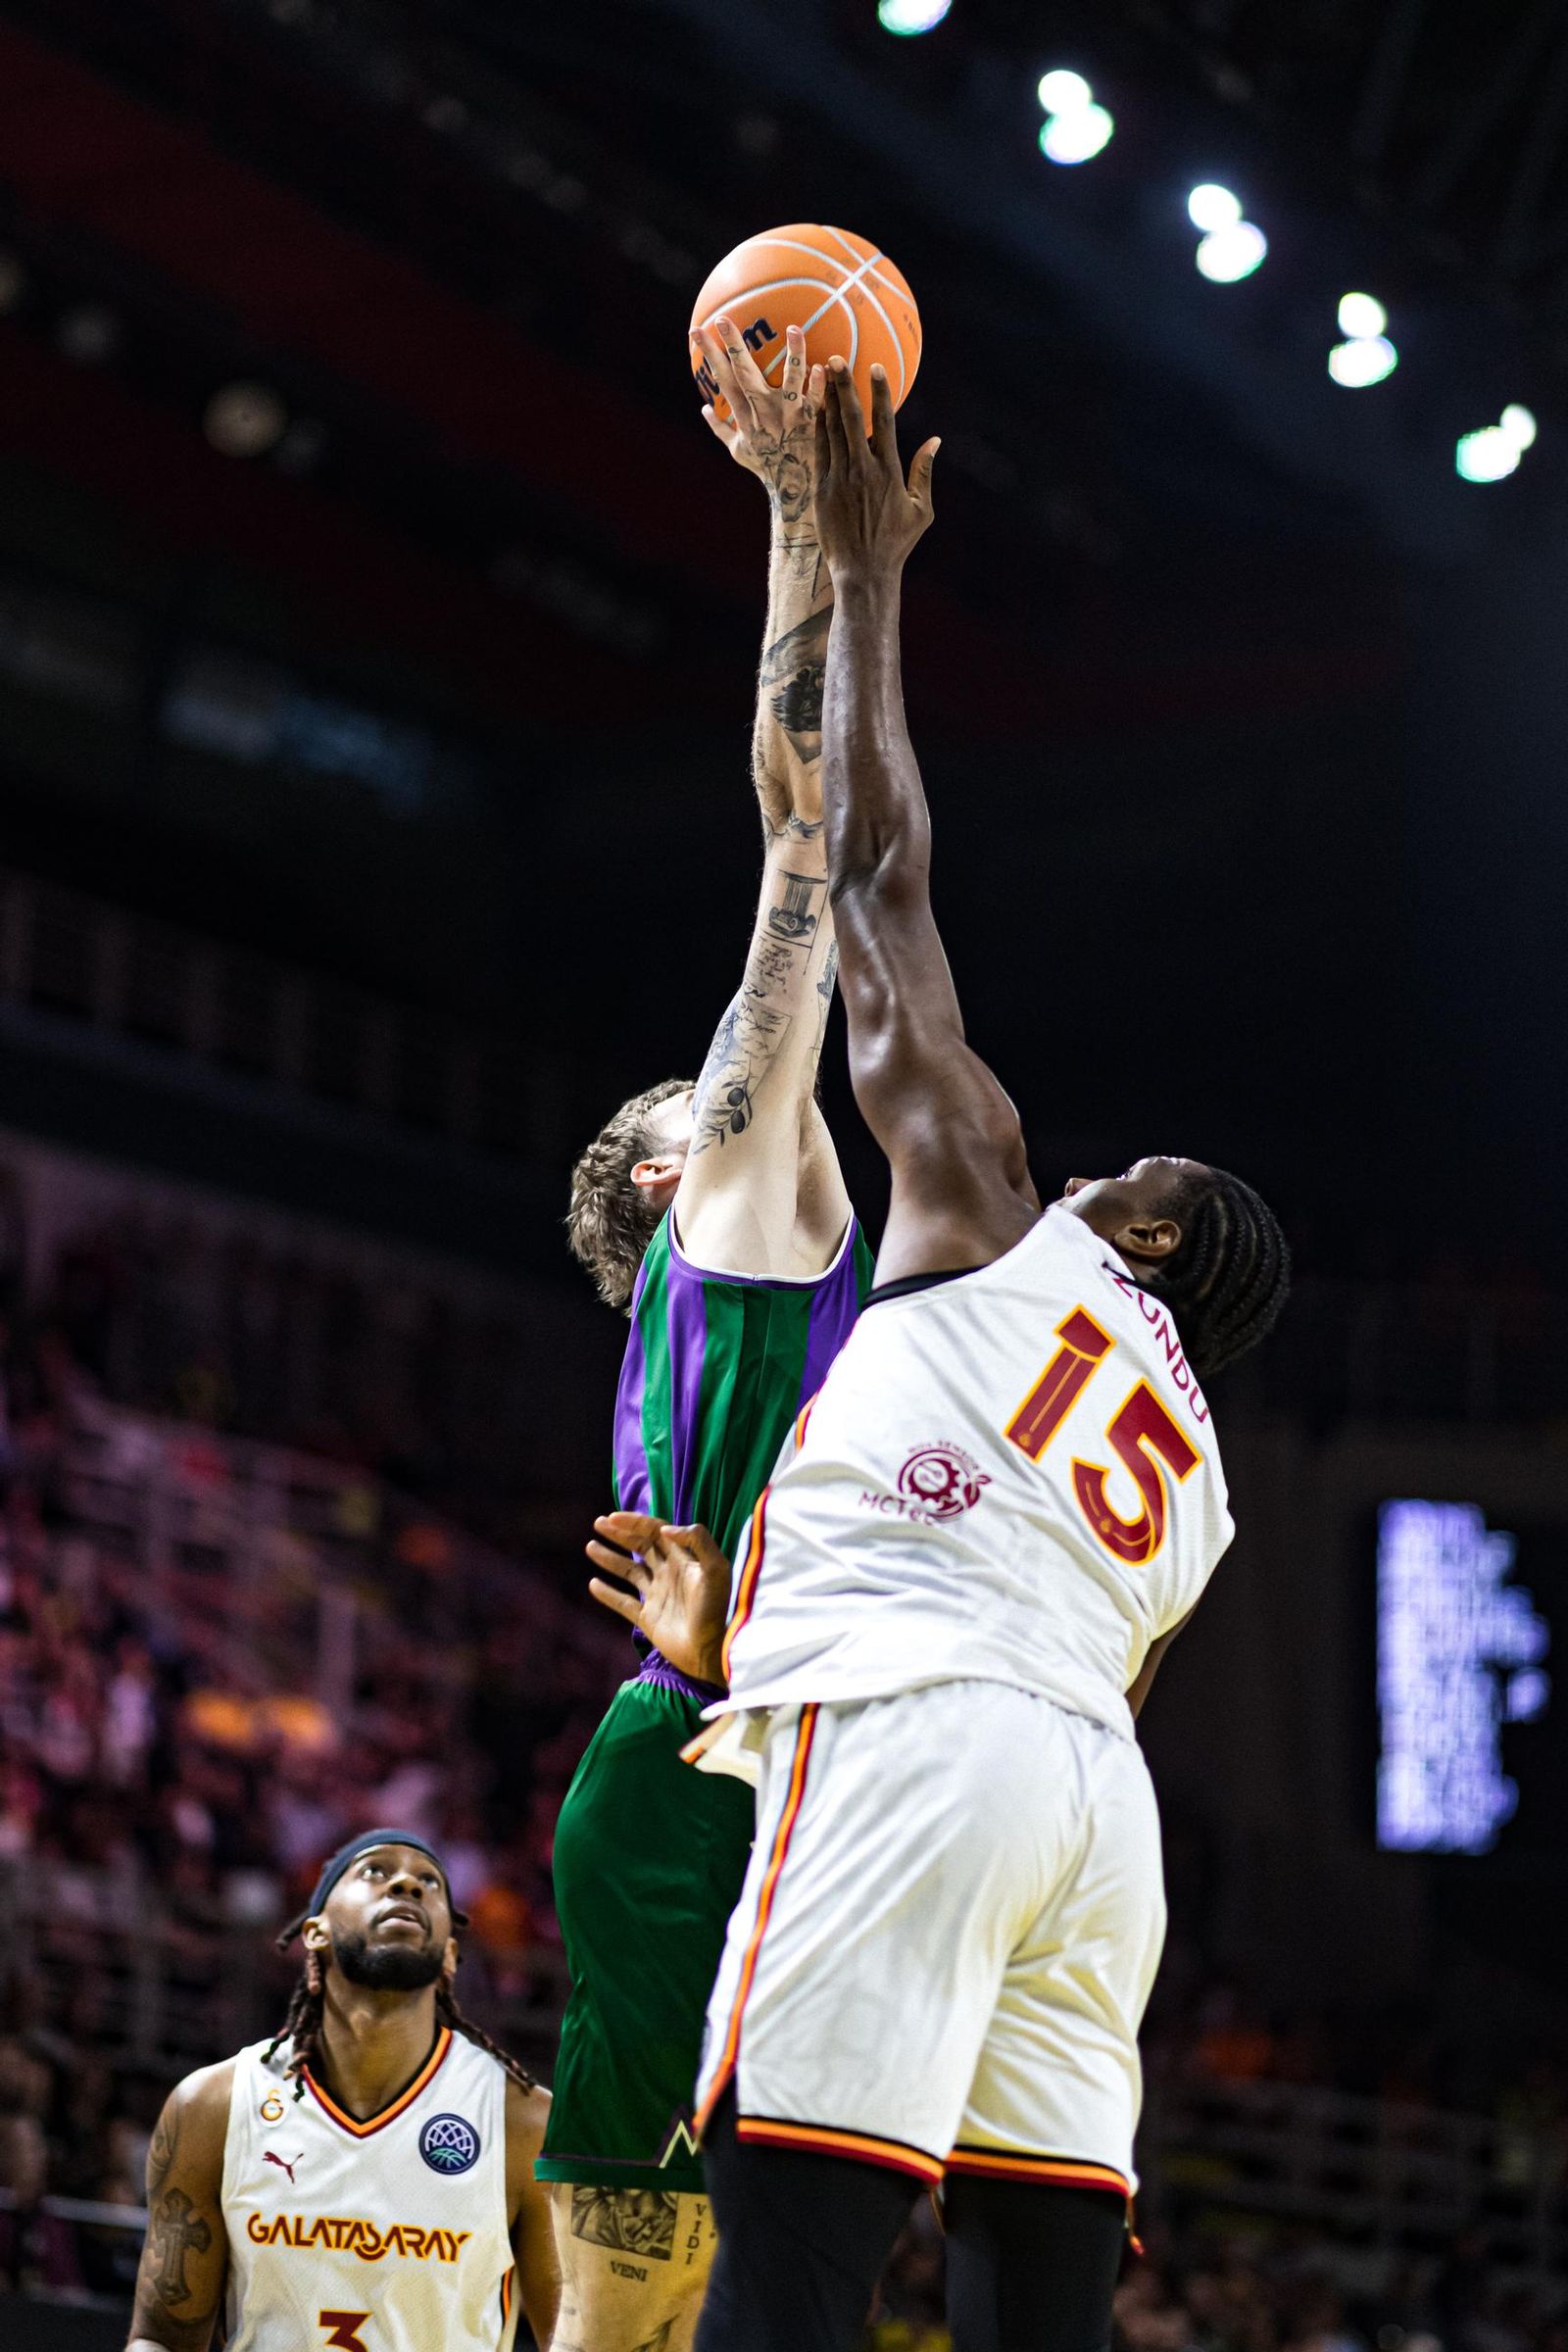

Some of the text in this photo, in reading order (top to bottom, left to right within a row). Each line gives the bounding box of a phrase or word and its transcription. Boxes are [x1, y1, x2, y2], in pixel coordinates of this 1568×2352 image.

[1004, 1303, 1203, 1567] 15
[246, 2211, 472, 2264] GALATASARAY
[610, 2260, 648, 2282] VENI
